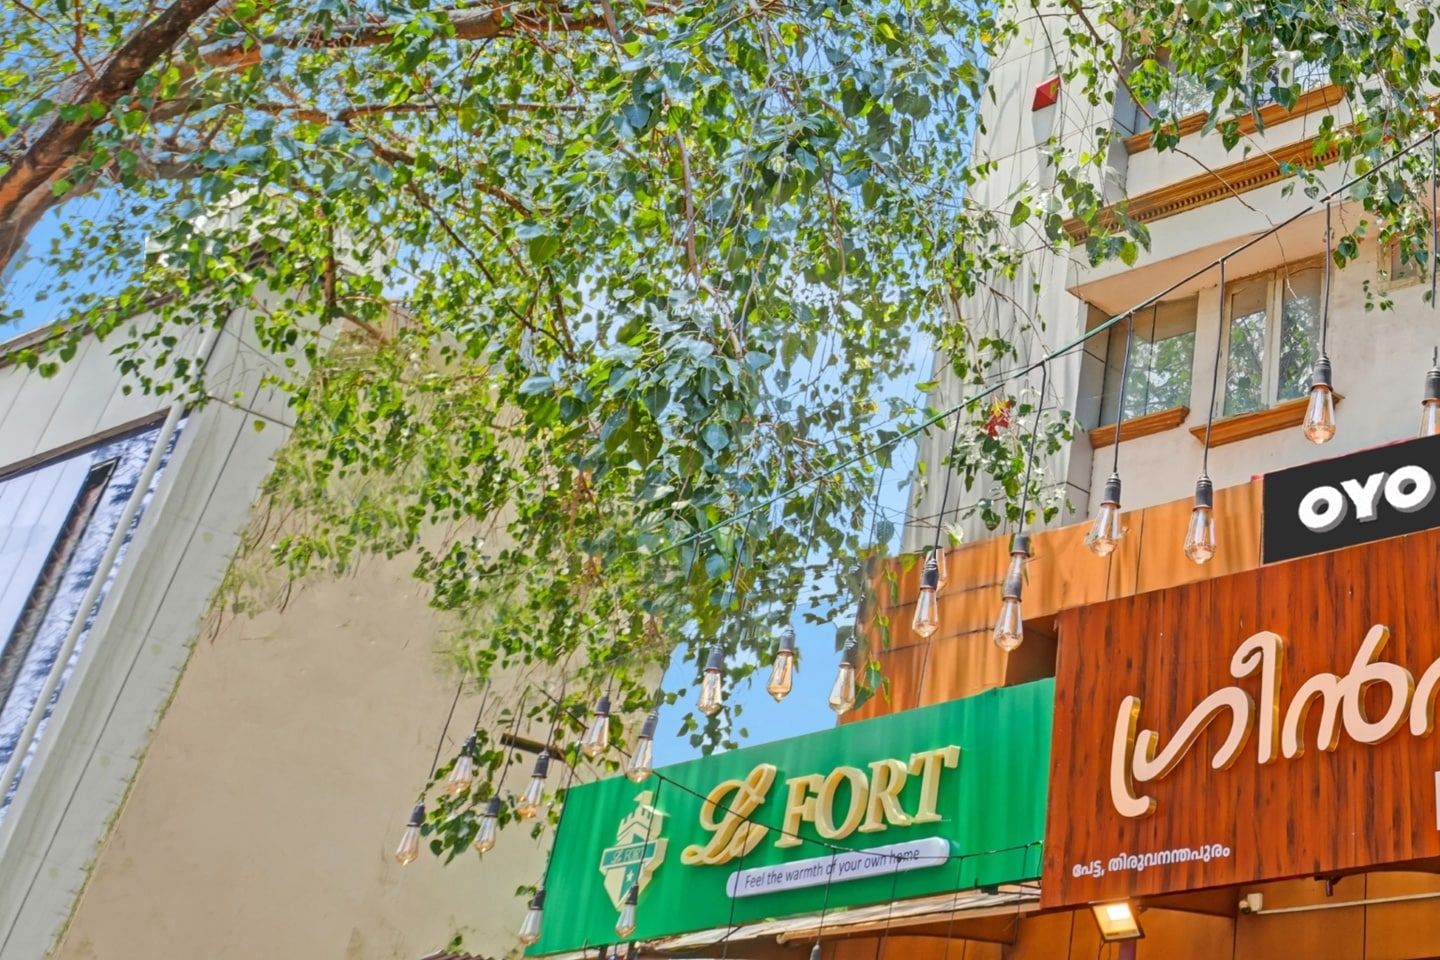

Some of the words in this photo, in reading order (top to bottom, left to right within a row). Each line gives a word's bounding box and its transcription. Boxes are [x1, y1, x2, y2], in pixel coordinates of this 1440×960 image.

[1297, 465, 1437, 533] OYO
[774, 745, 961, 848] FORT
[744, 871, 765, 889] Feel
[766, 869, 783, 885] the
[785, 864, 824, 882] warmth
[825, 858, 838, 874] of
[838, 858, 862, 877] your
[864, 854, 888, 868] own
[889, 847, 920, 863] home
[1108, 843, 1231, 872] തിരുവനന്തപുരം
